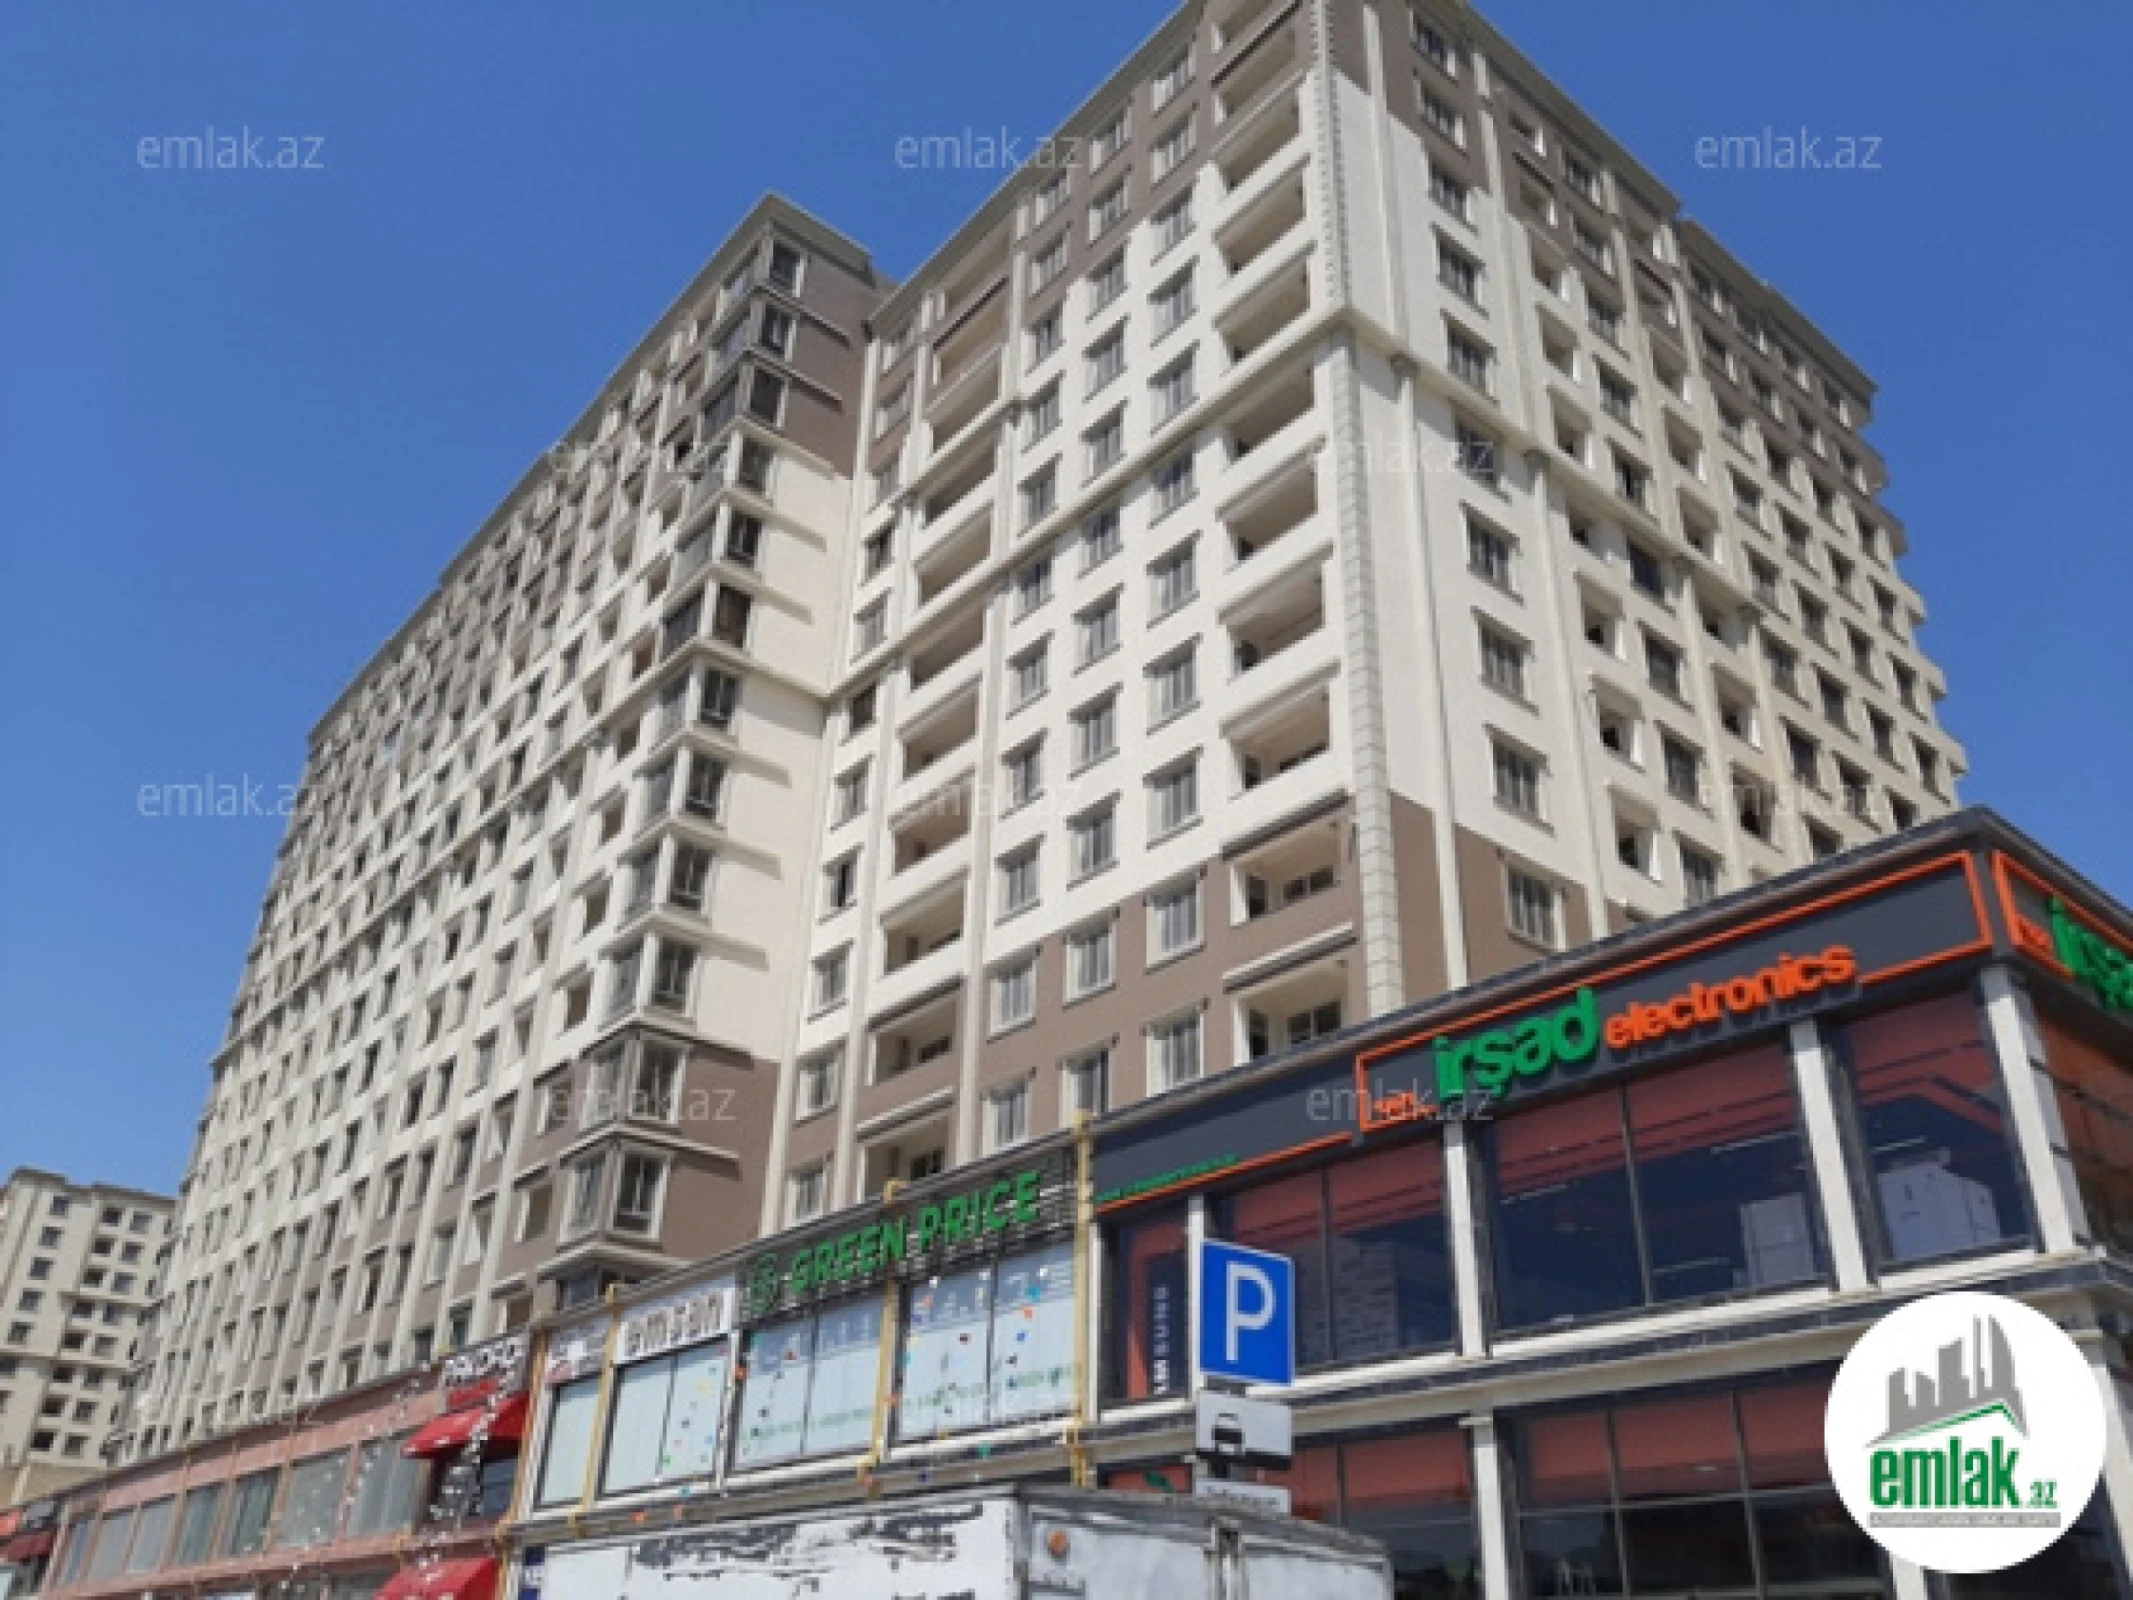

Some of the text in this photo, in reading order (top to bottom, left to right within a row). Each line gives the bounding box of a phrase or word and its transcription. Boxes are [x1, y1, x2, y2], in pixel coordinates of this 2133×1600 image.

[1604, 944, 1858, 1050] electronics
[790, 1215, 907, 1294] GREEN
[917, 1170, 1041, 1252] PRICE
[1226, 1261, 1277, 1363] P
